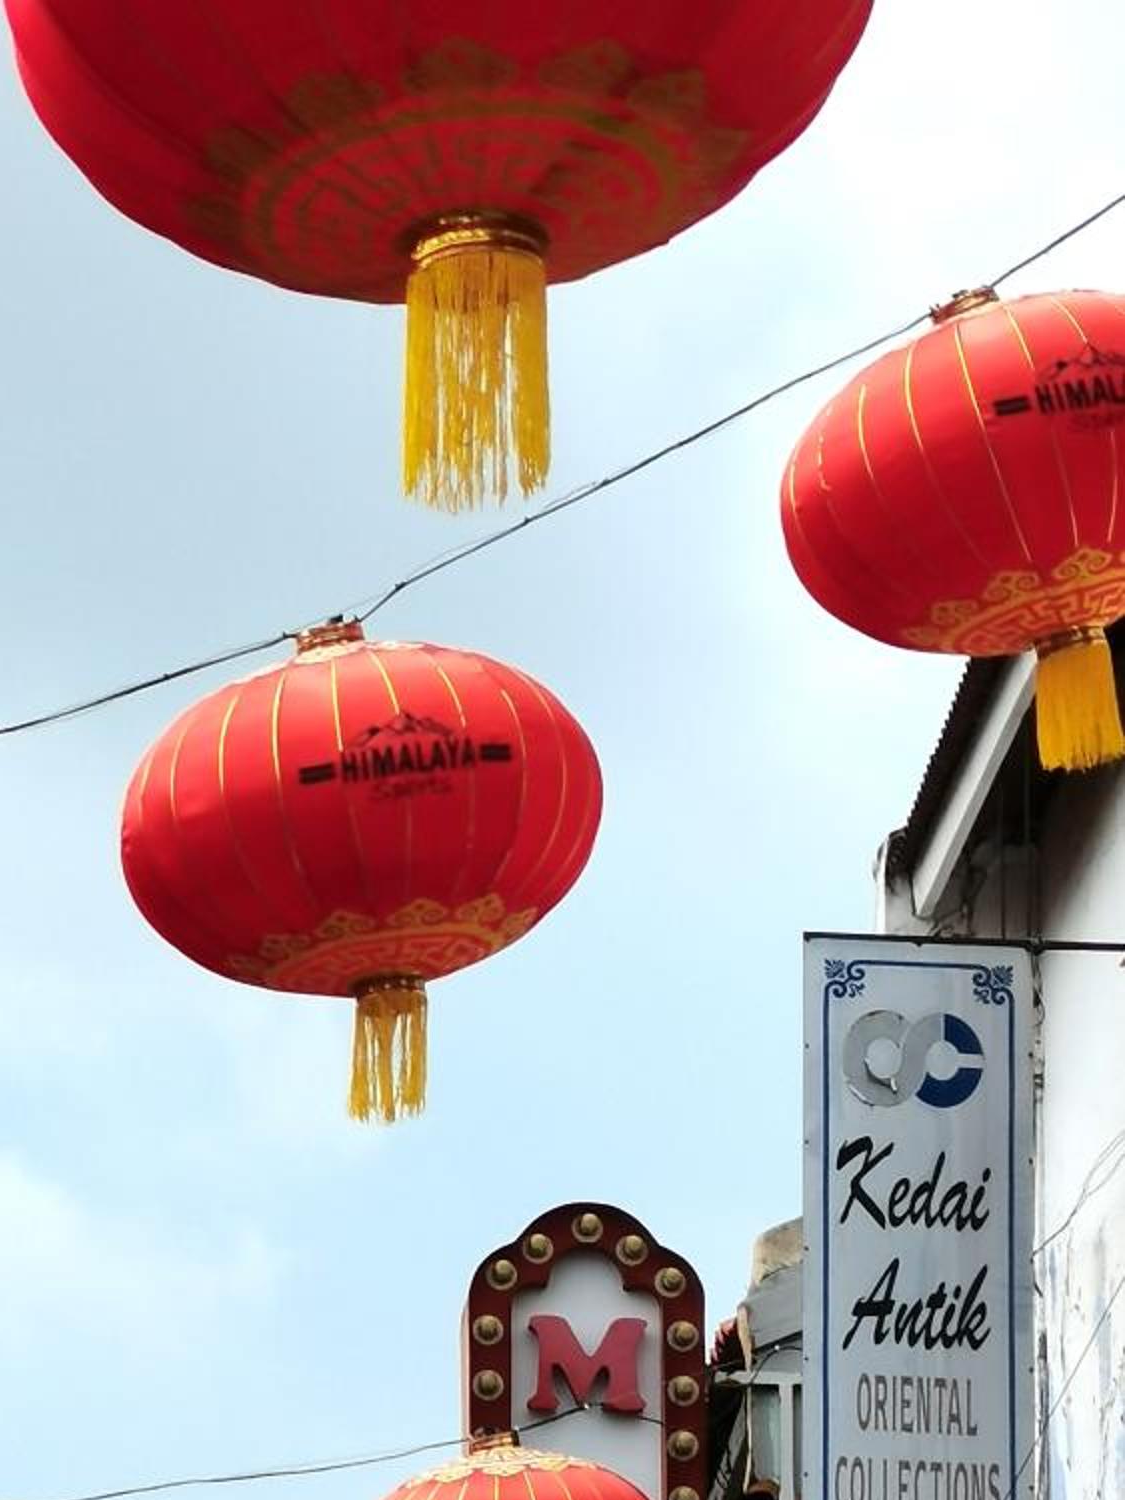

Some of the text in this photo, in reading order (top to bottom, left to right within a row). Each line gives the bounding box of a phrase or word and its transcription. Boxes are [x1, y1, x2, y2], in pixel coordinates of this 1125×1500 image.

[1035, 374, 1125, 414] HIMAL
[341, 738, 475, 783] HIMALAYA
[836, 1136, 991, 1232] Kedai
[842, 1258, 991, 1351] Antik
[856, 1373, 978, 1435] ORIENTAL
